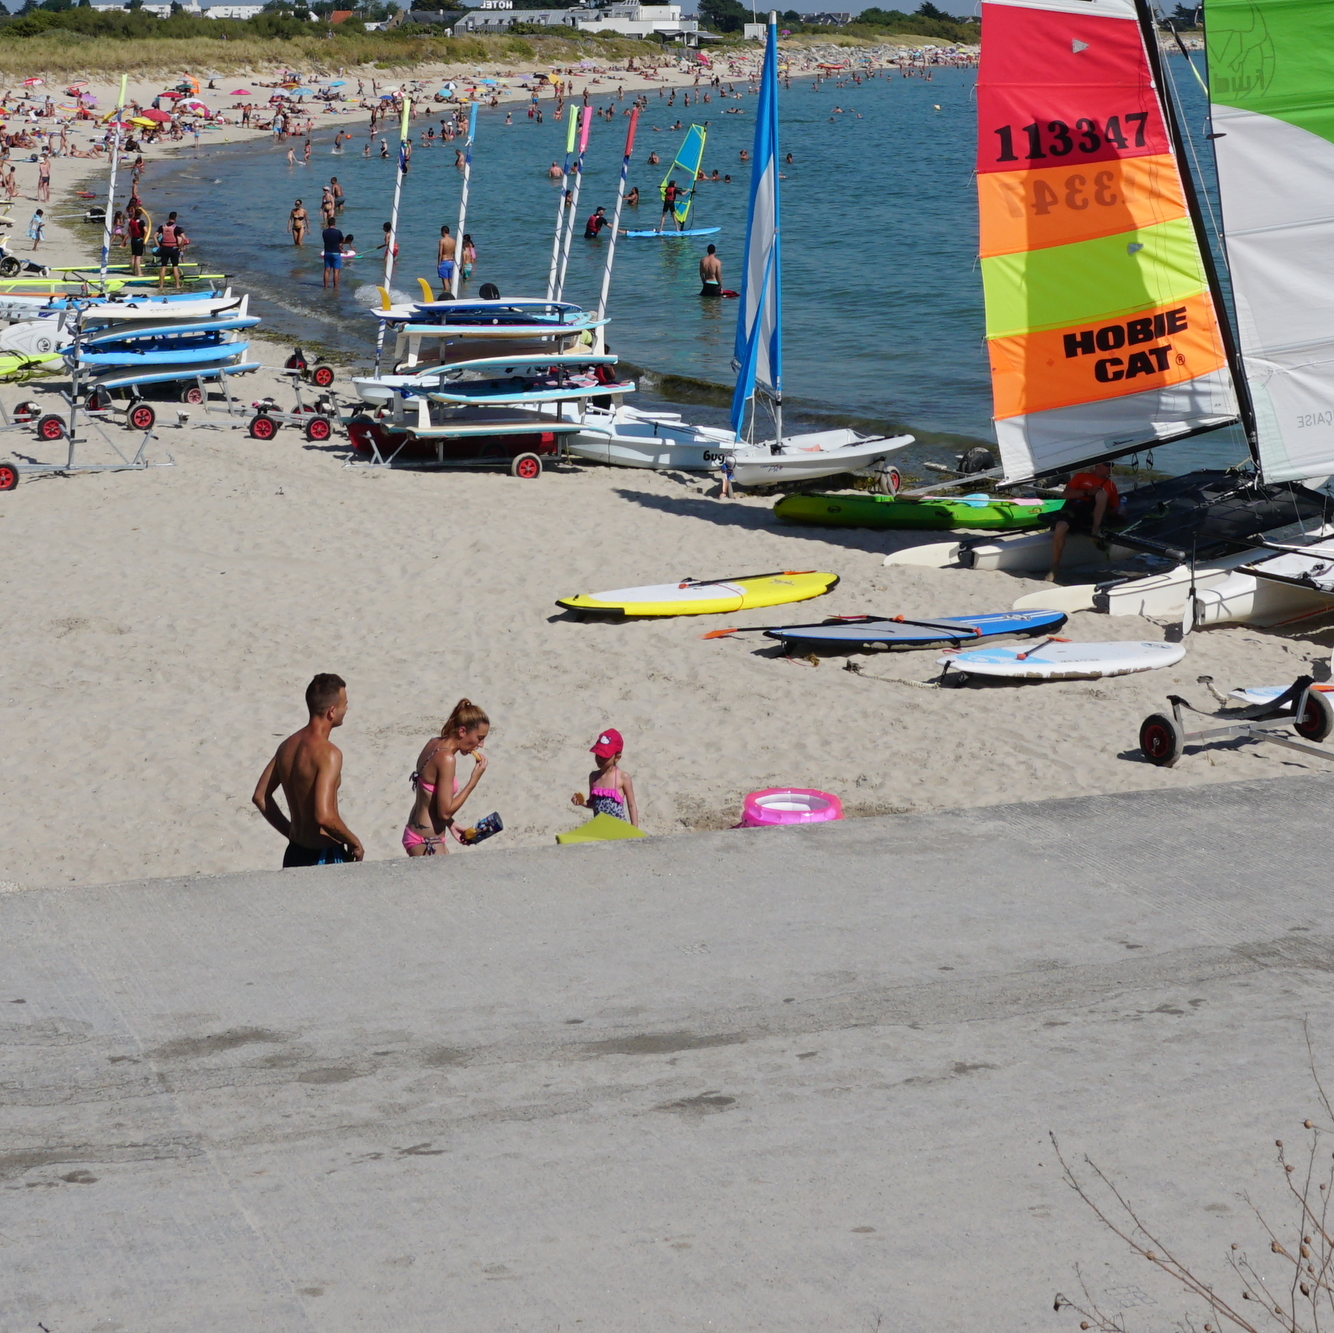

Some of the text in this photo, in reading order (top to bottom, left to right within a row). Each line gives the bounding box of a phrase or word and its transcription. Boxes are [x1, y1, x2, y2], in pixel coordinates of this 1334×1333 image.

[994, 111, 1149, 162] 113347
[1063, 306, 1188, 359] HOBIE
[1094, 344, 1172, 383] CAT
